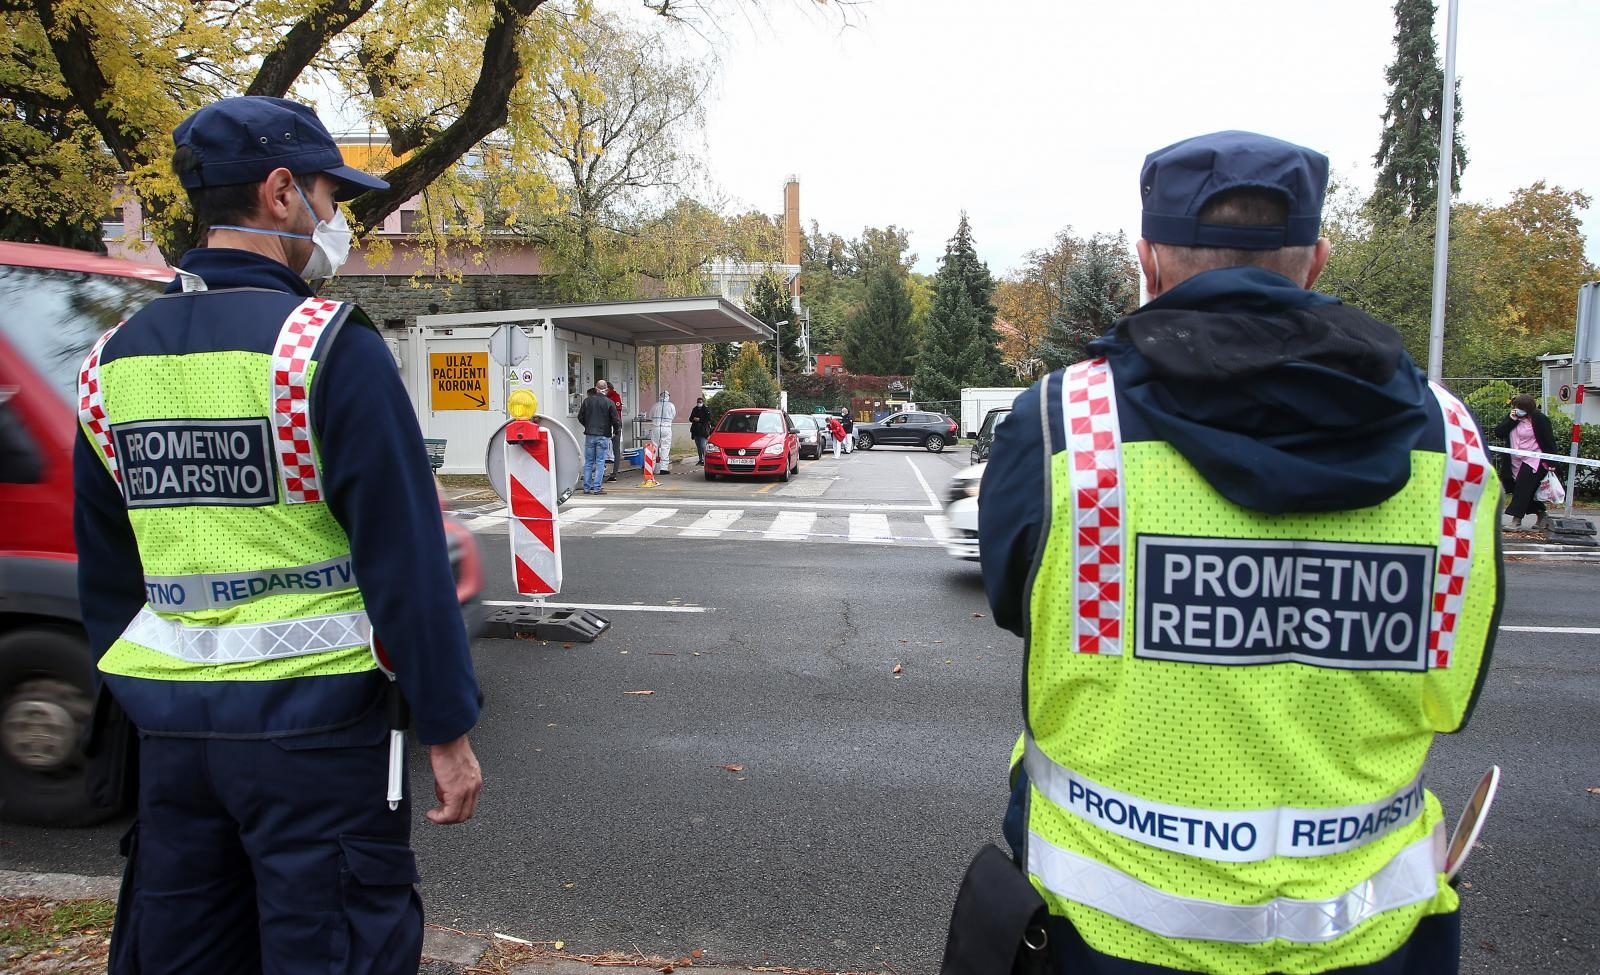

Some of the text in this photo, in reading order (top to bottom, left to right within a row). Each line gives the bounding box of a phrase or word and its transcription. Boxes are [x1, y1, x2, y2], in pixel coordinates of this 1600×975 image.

[433, 367, 486, 380] PACIJENTI
[446, 355, 473, 367] ULAZ
[438, 380, 482, 392] KORONA
[126, 431, 250, 462] PROMETNO
[128, 465, 262, 496] REDARSTVO
[144, 560, 353, 606] TNO REDARSTV
[1163, 553, 1409, 604] PROMETNO
[1151, 602, 1414, 653] REDARSTVO
[1069, 779, 1258, 852] PROMETNO
